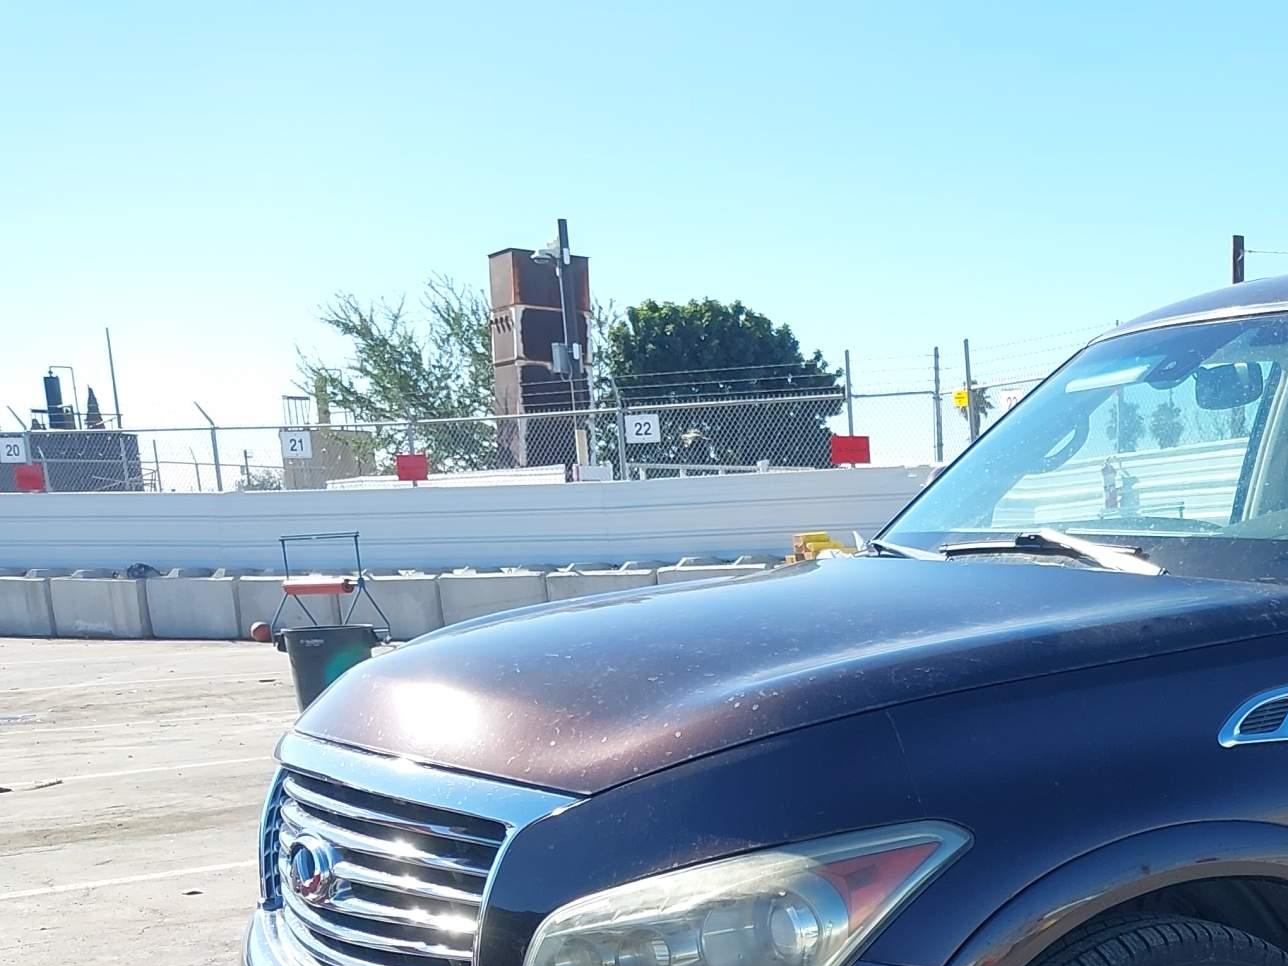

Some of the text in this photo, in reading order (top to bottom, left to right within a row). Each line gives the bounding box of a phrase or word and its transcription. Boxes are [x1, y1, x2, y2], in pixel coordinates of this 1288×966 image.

[634, 421, 653, 436] 22
[5, 443, 20, 457] 20
[289, 438, 305, 452] 21
